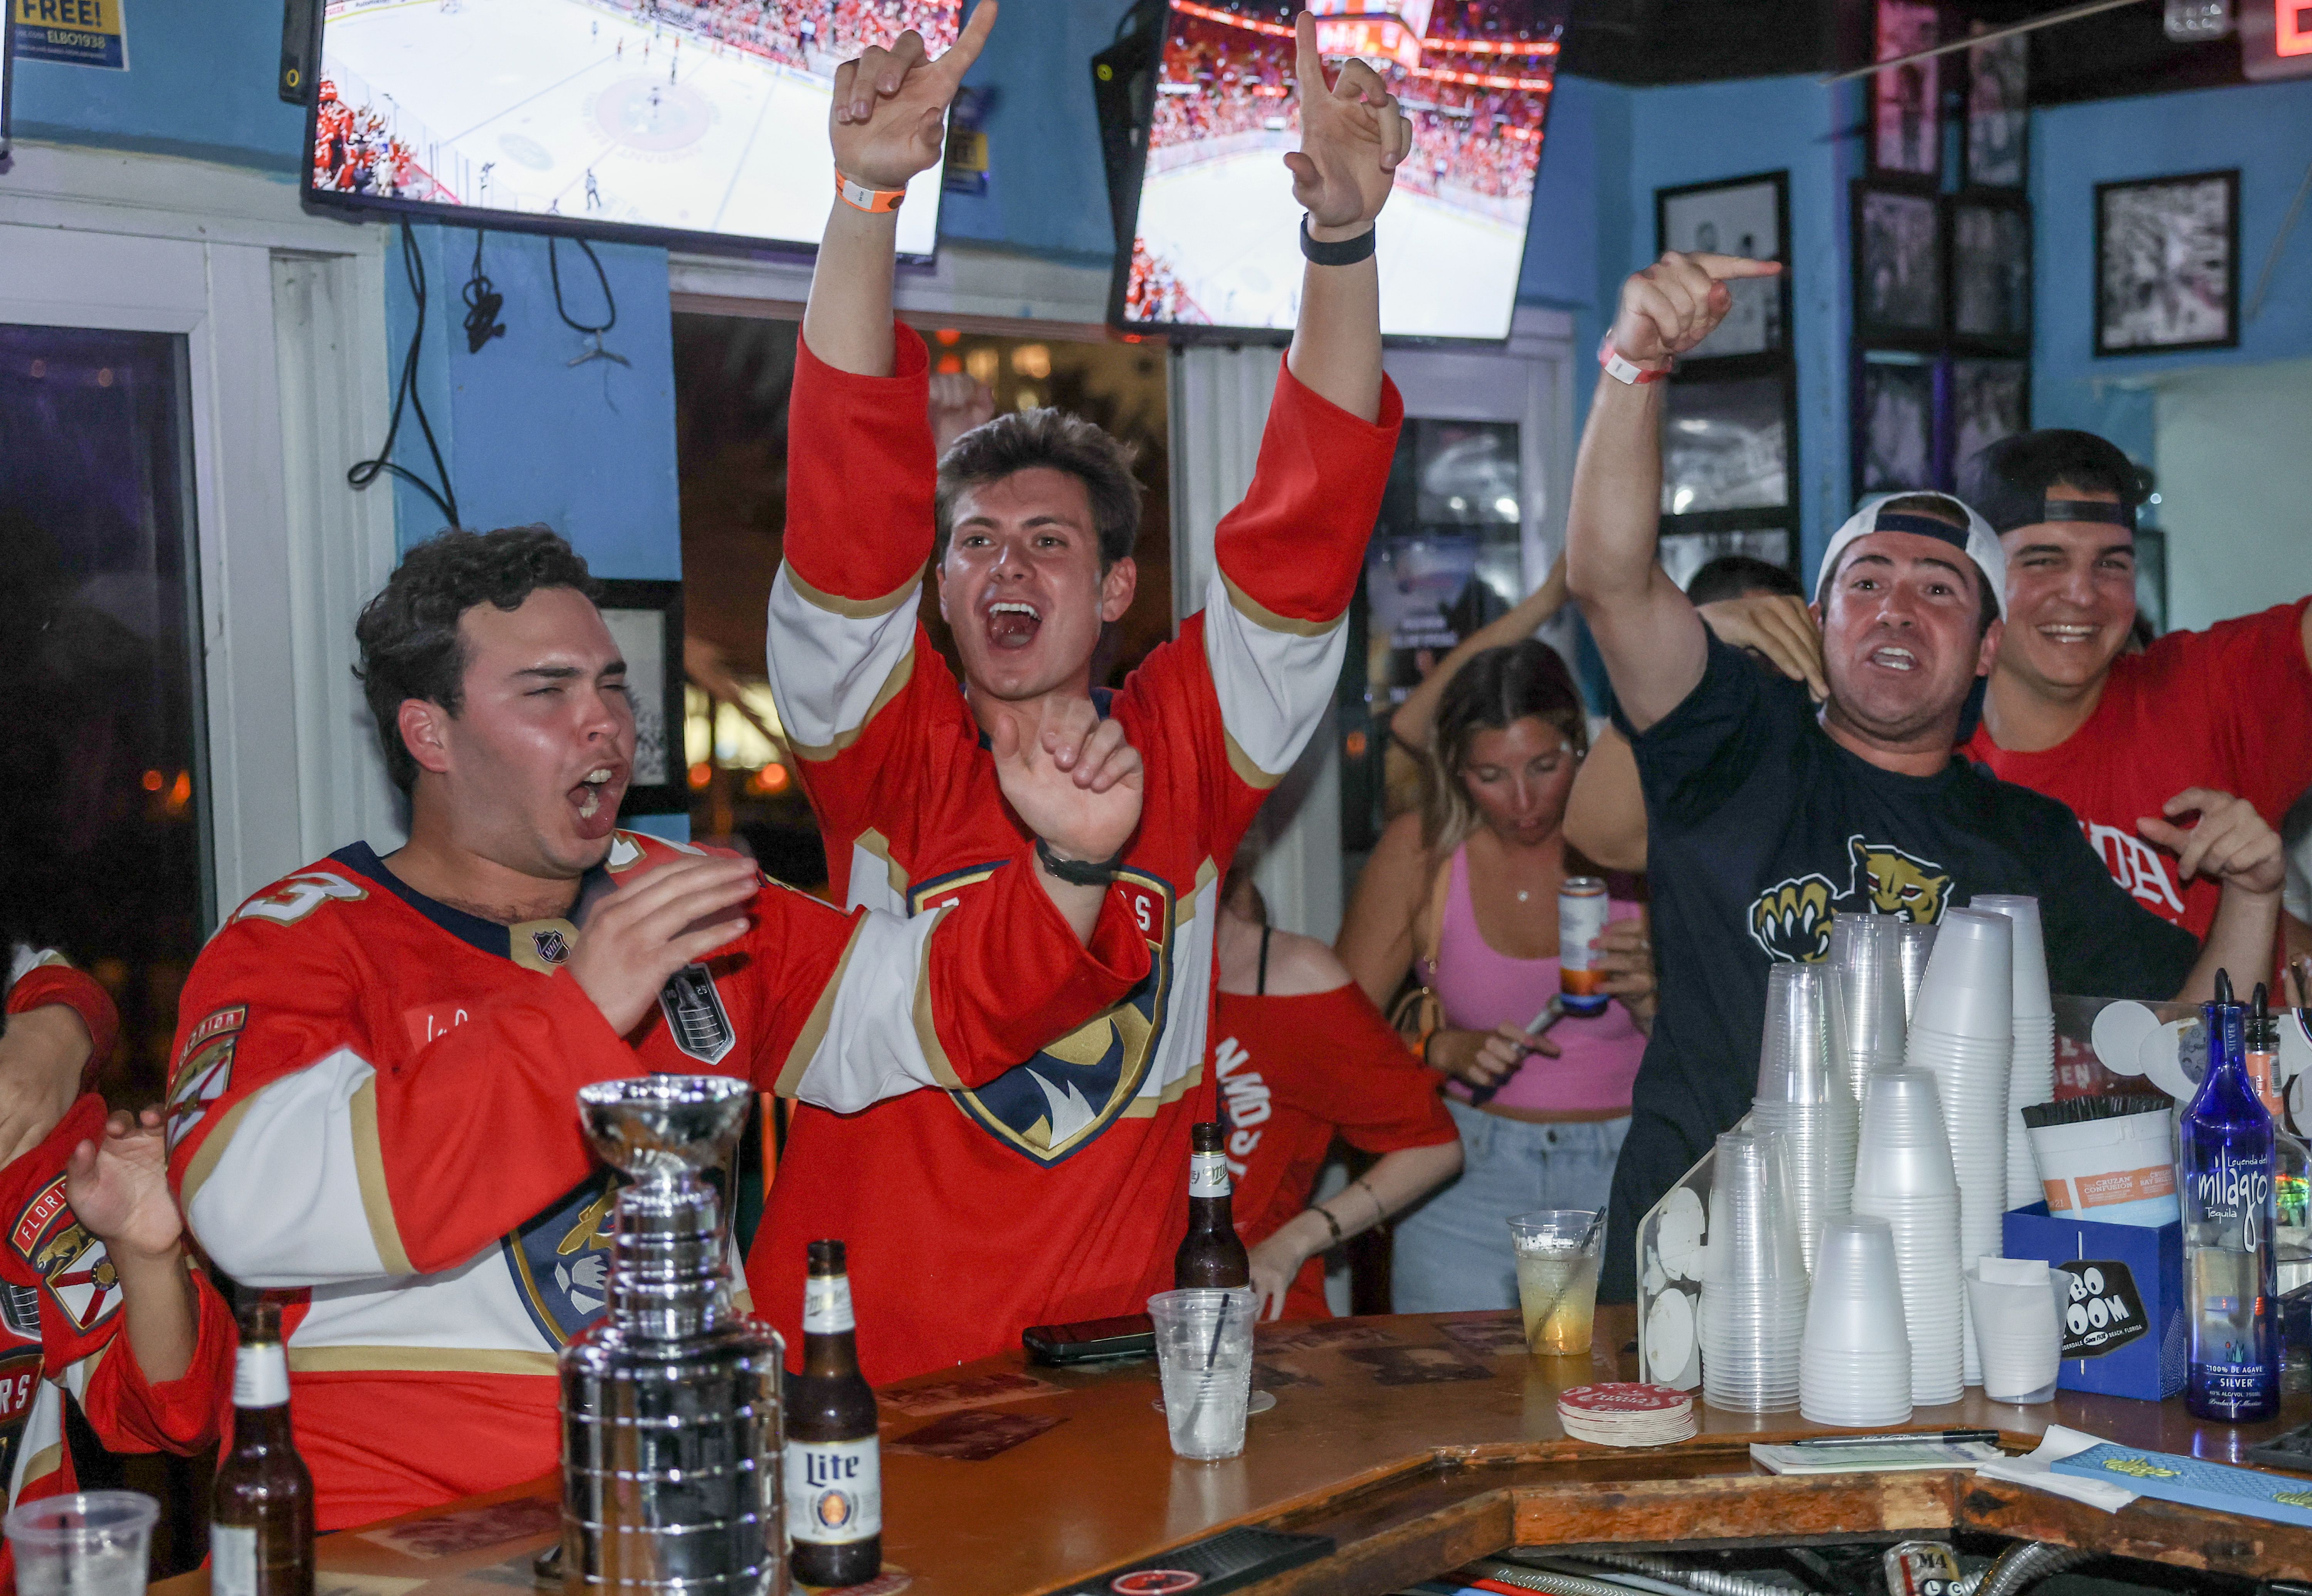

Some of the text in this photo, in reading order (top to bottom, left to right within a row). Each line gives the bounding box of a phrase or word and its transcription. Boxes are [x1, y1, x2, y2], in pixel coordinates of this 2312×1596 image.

[22, 0, 102, 27] FREE!
[545, 939, 561, 959] NHL
[696, 986, 707, 995] 25
[2228, 1154, 2267, 1171] Leyenda del
[2084, 1182, 2133, 1194] CONFUSION
[2096, 1176, 2131, 1186] CRUZAN
[2198, 1145, 2268, 1253] milagro
[2205, 1207, 2237, 1224] Tequila
[2066, 1294, 2130, 1336] OOM
[2125, 1324, 2142, 1334] FLORIDA
[2220, 1378, 2253, 1388] SILVER
[805, 1452, 860, 1488] Lite
[1929, 1581, 1961, 1594] L C
